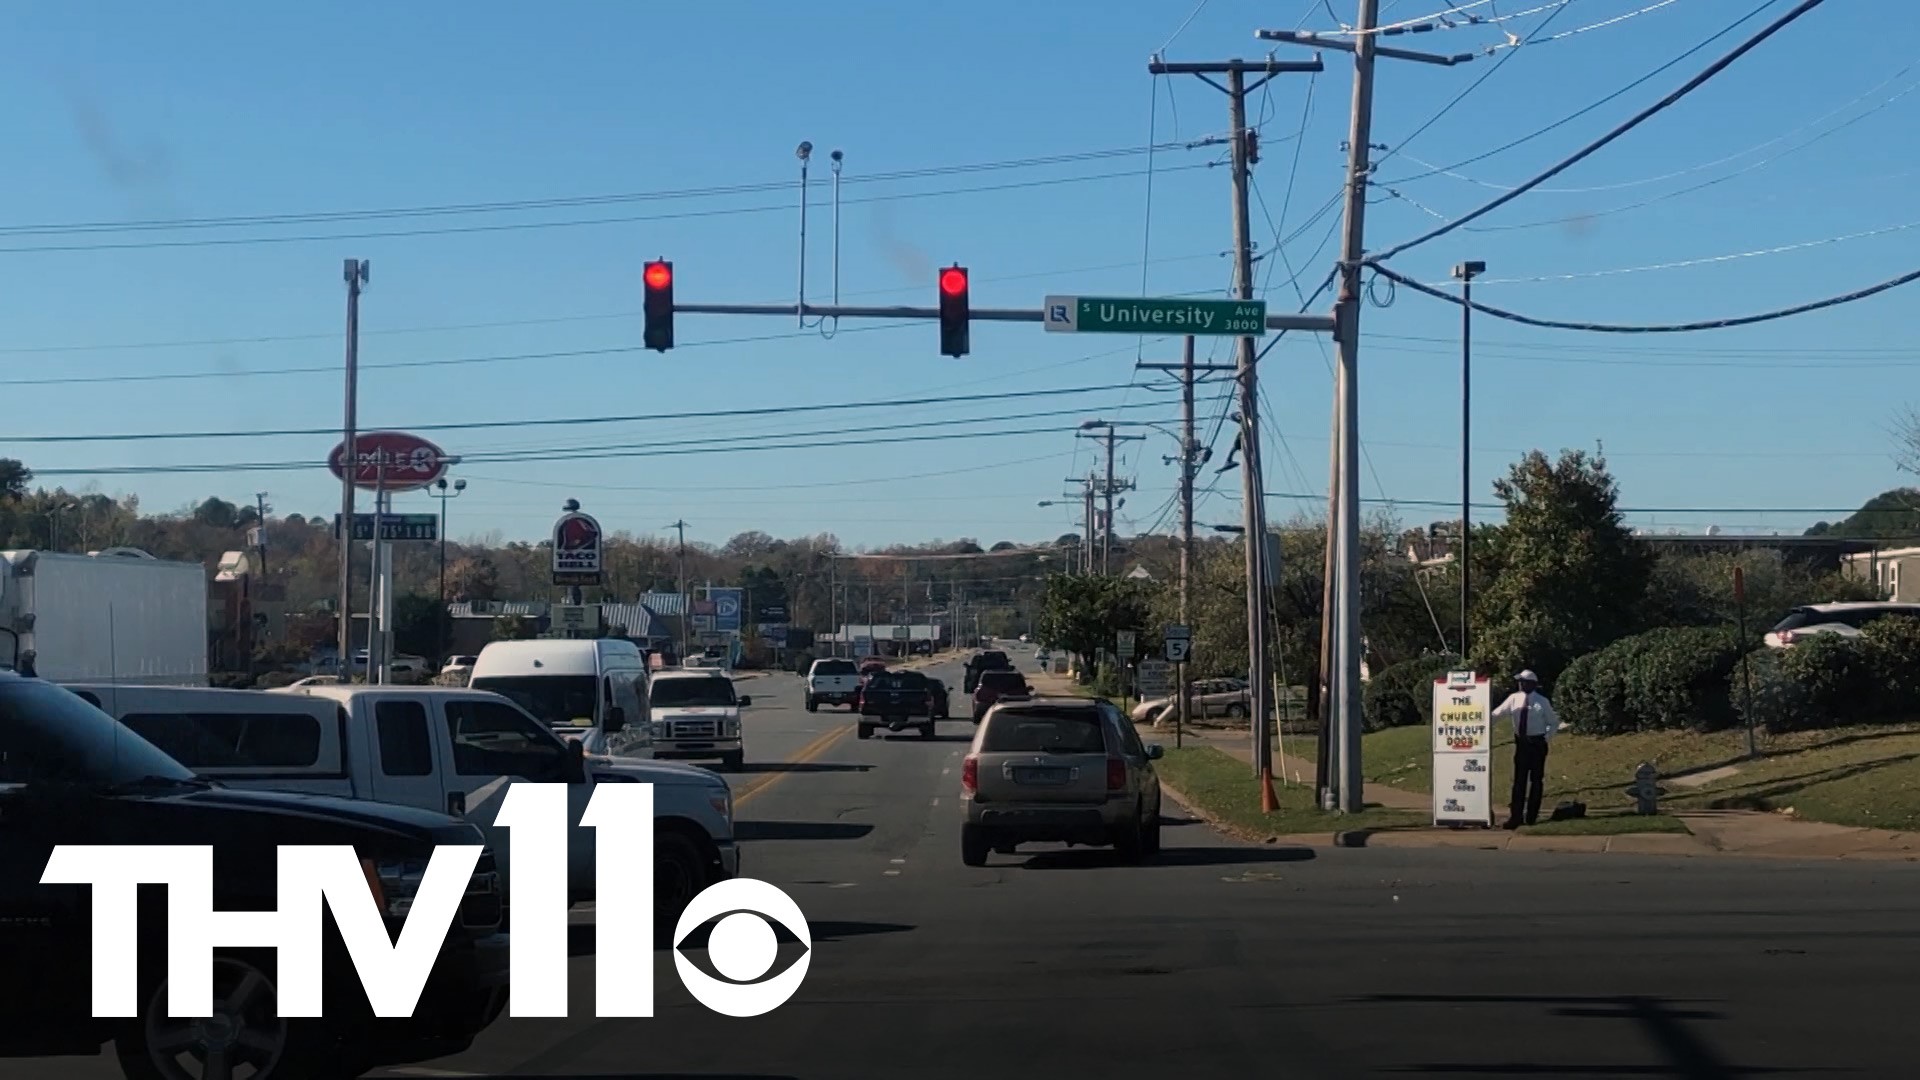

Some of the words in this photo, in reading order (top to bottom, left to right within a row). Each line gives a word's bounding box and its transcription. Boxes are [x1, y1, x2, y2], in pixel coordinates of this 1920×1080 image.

[1100, 303, 1215, 328] University
[1235, 305, 1259, 316] Ave
[1224, 319, 1259, 330] 3800
[557, 552, 596, 560] TACO
[1172, 643, 1182, 656] 5
[1452, 697, 1471, 705] THE
[1440, 711, 1482, 722] CHURCH
